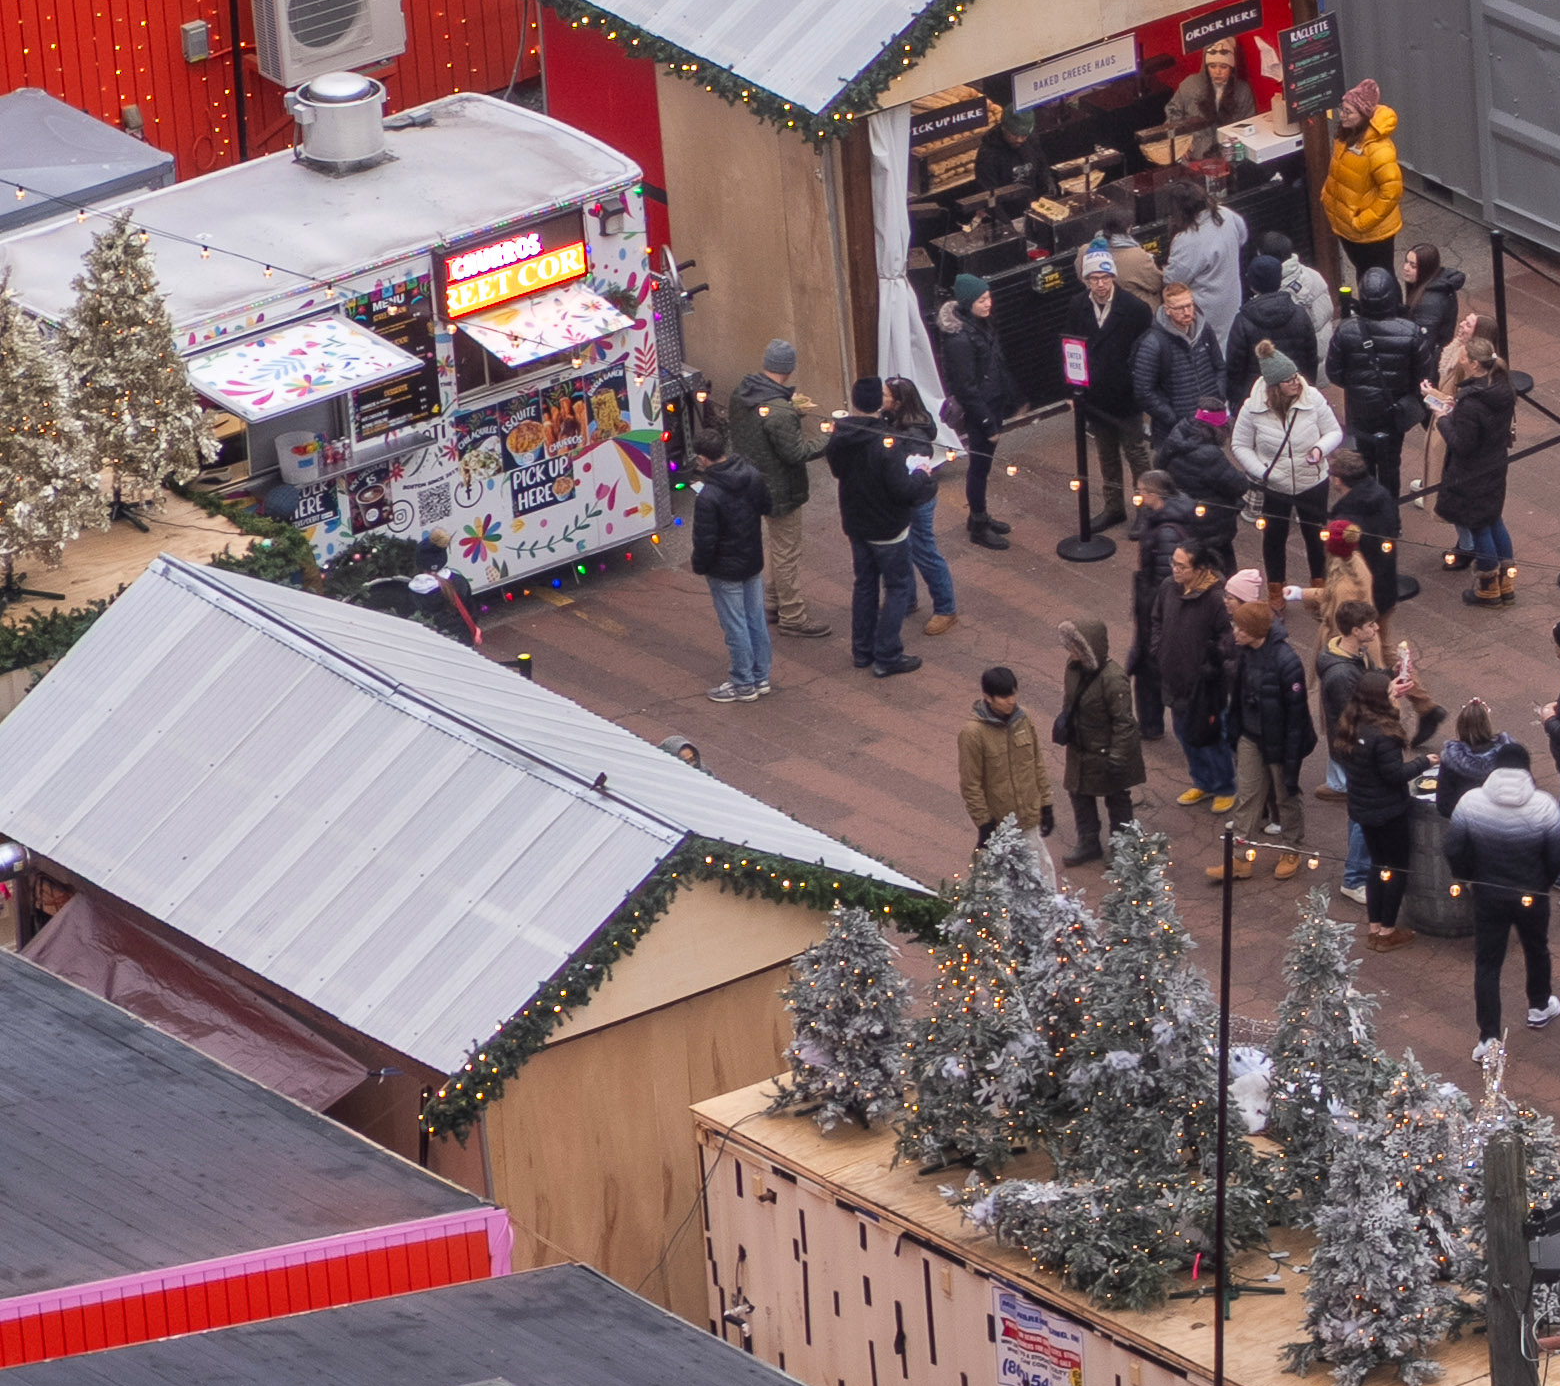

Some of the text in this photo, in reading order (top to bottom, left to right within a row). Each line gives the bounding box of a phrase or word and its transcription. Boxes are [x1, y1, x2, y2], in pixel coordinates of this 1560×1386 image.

[1184, 8, 1259, 44] ORDER HERE
[1289, 20, 1330, 44] RACLETTE
[1032, 54, 1117, 93] BAKED CHEESE HAUS
[450, 232, 543, 280] CHURROS
[372, 293, 406, 313] MENU
[501, 406, 537, 435] ESQUITE
[512, 456, 570, 490] PICK UP
[517, 485, 554, 512] HERE
